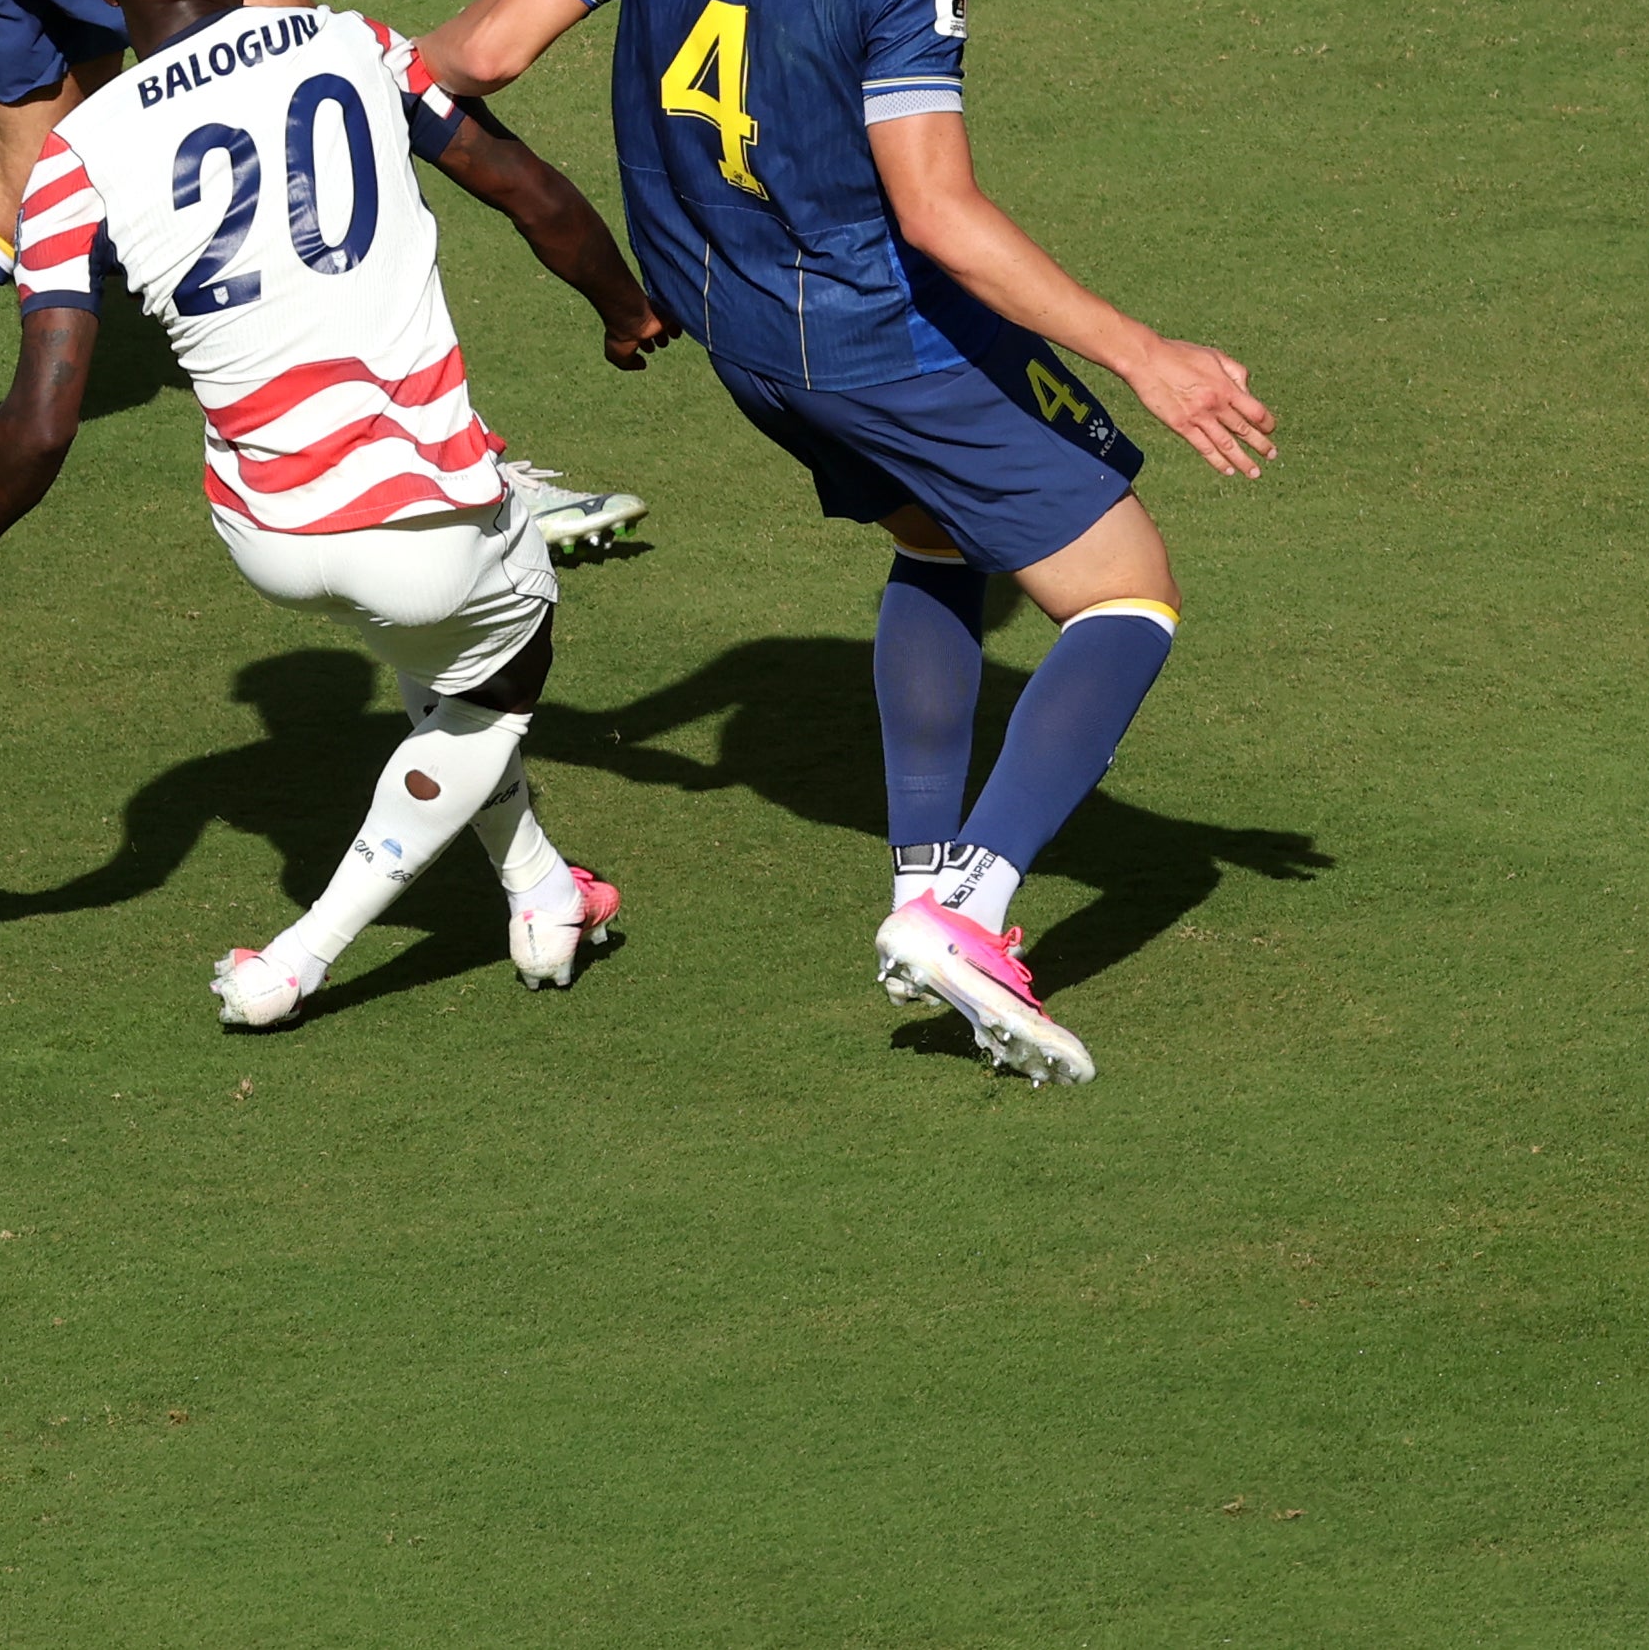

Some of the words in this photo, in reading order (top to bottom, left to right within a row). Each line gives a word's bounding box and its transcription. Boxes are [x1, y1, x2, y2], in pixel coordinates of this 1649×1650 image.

[137, 13, 319, 109] BALOGUN
[172, 72, 378, 316] 20
[1026, 358, 1090, 424] 4
[1100, 427, 1118, 457] KELM
